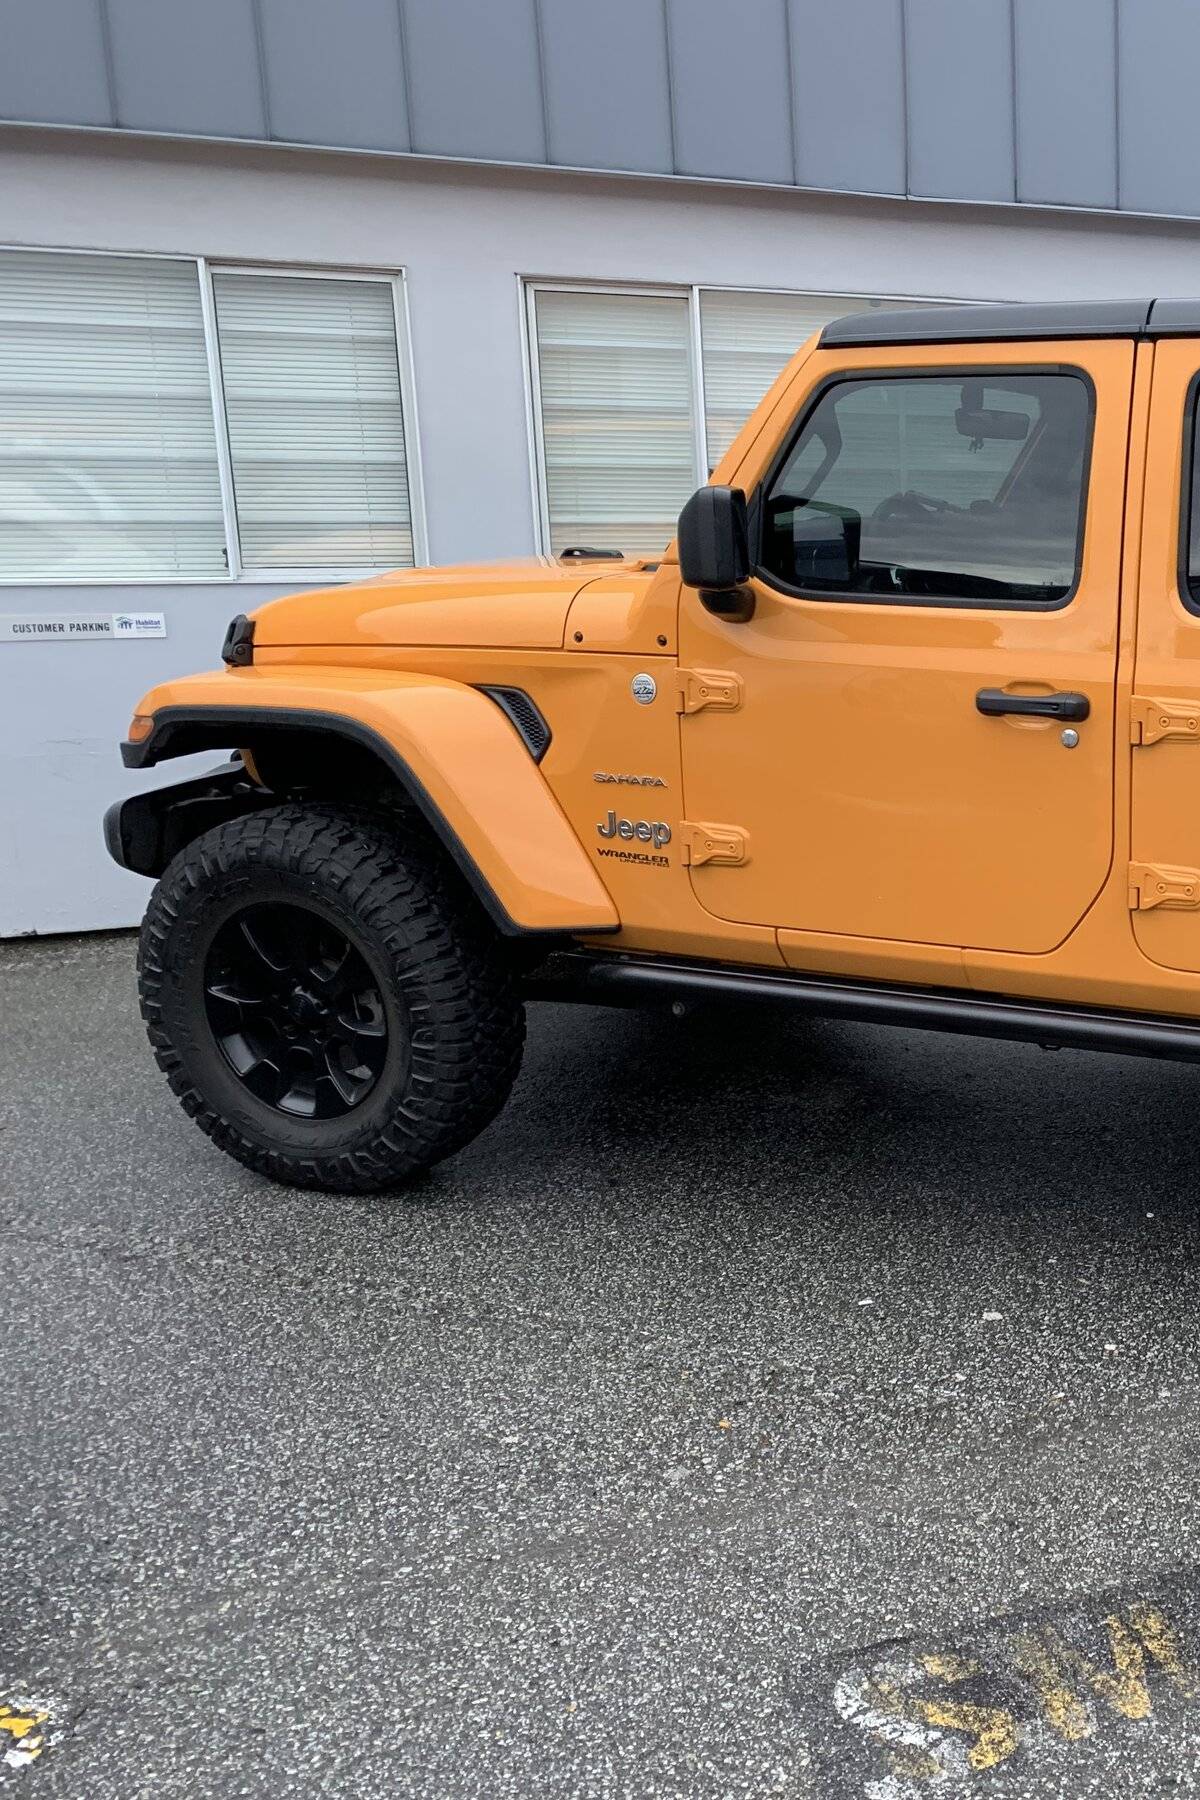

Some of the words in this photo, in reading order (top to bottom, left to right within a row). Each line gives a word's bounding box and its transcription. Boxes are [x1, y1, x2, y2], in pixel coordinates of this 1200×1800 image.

[12, 623, 65, 633] CUSTOMER
[69, 622, 111, 632] PARKING
[592, 772, 668, 788] SAHARA
[597, 810, 672, 849] Jeep
[596, 848, 669, 864] WRANGLER
